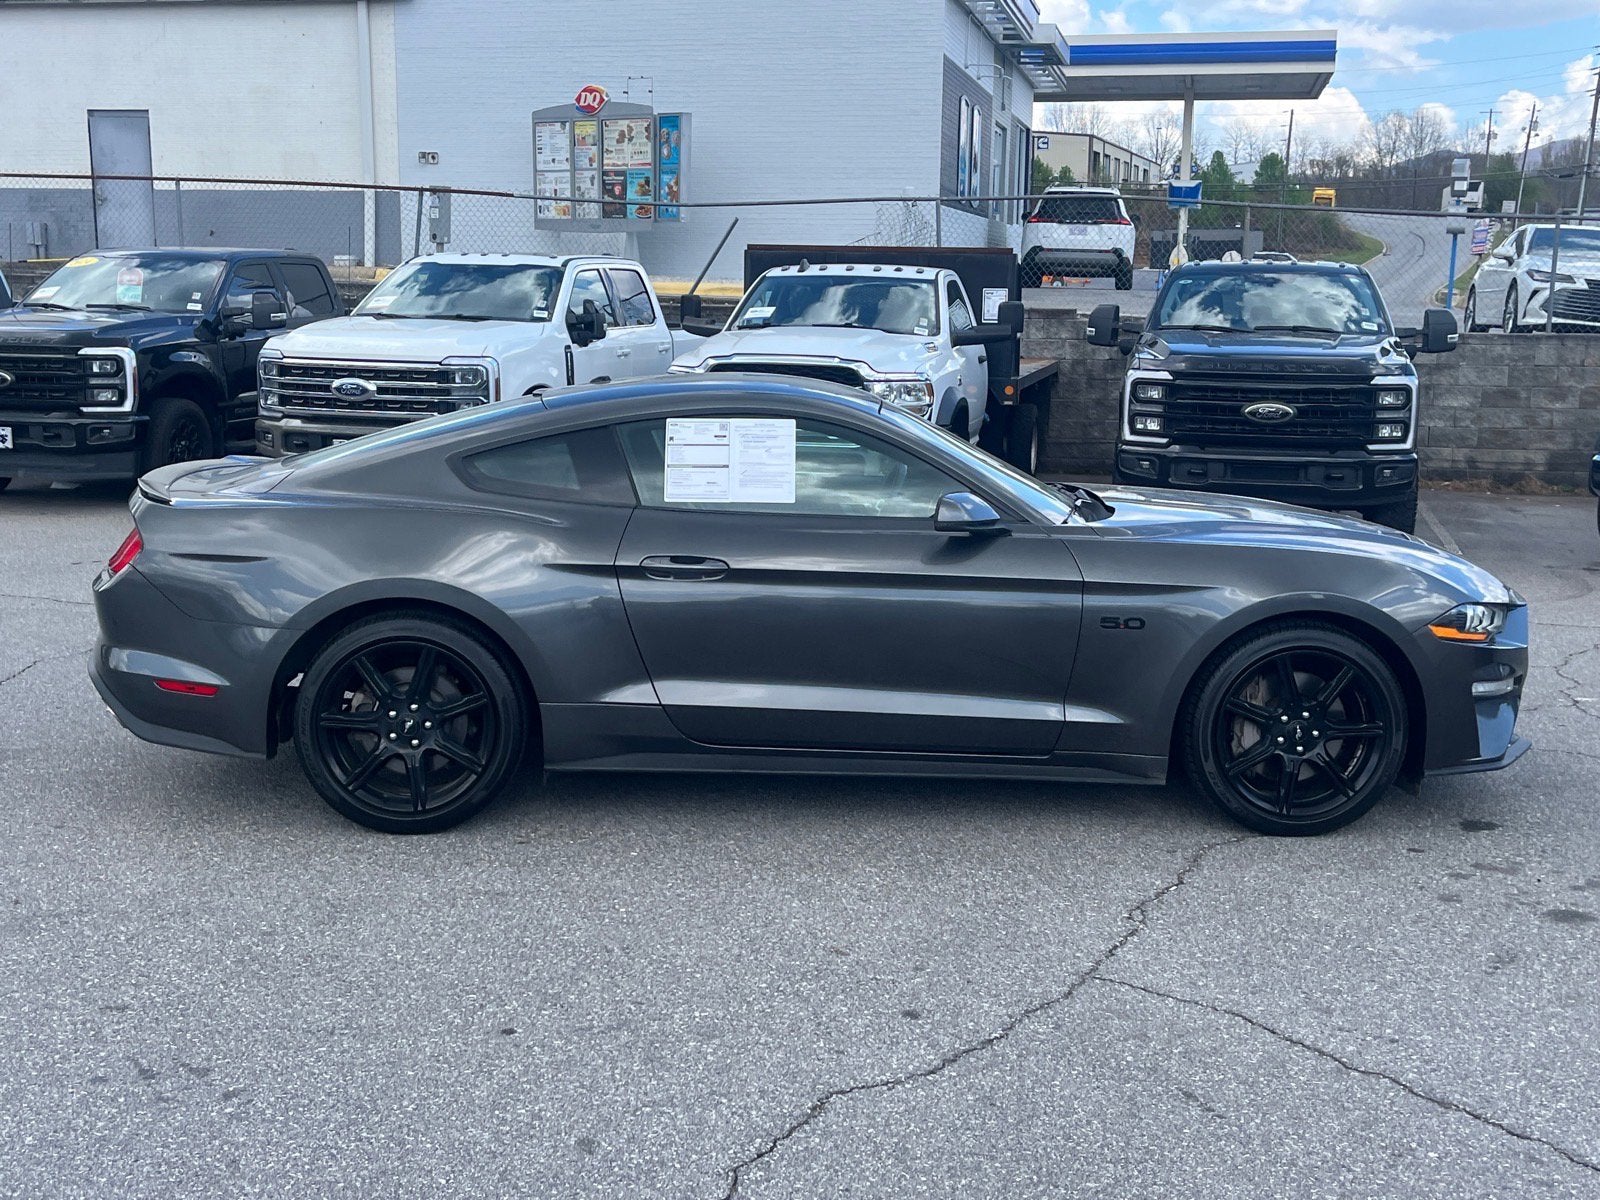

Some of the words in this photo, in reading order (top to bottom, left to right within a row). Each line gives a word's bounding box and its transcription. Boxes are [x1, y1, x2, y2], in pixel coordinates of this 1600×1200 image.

[579, 91, 600, 109] DQ
[341, 383, 364, 396] Ford
[1256, 407, 1283, 420] Ford
[1100, 616, 1146, 630] 5.0
